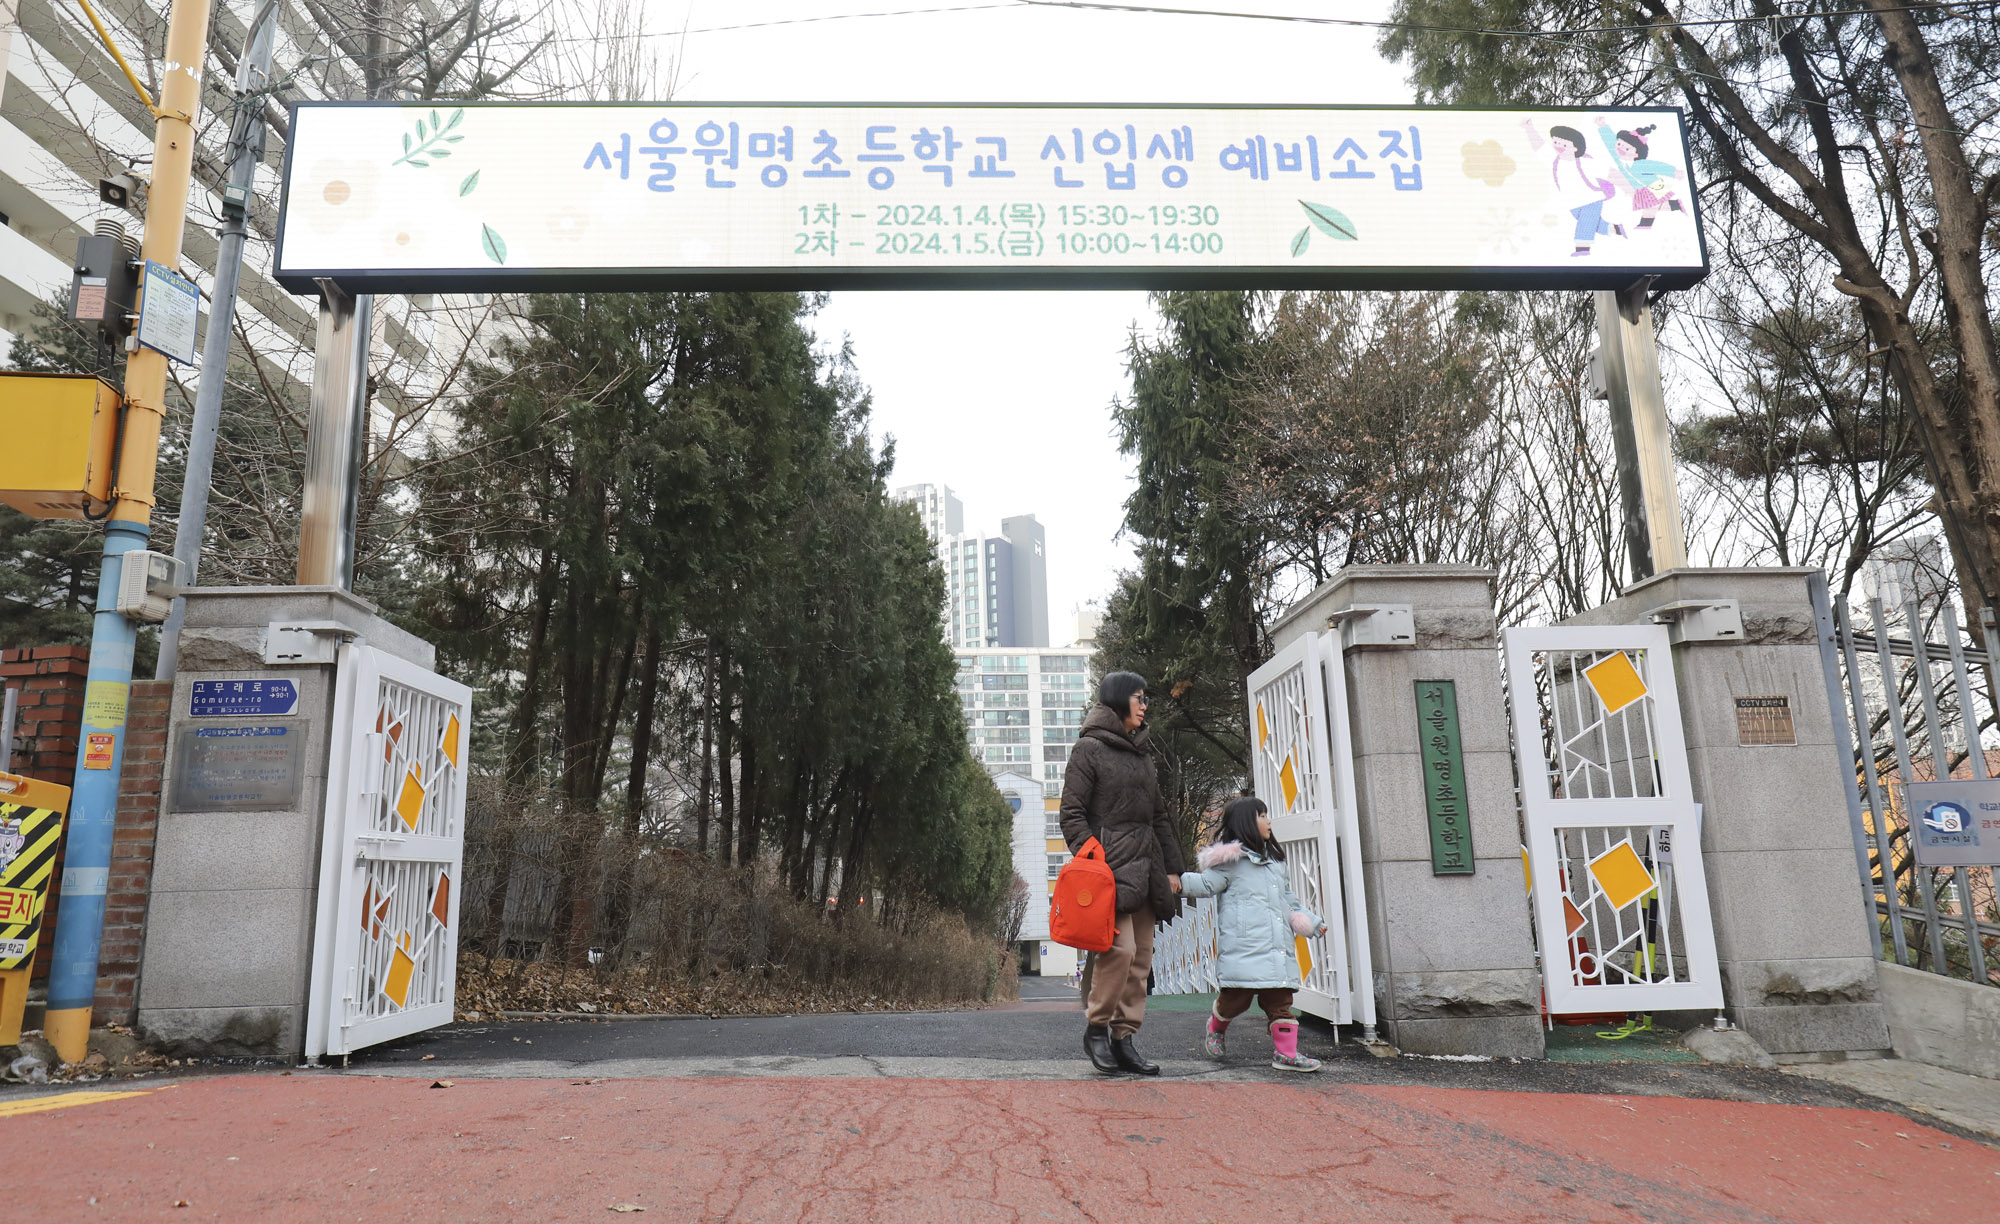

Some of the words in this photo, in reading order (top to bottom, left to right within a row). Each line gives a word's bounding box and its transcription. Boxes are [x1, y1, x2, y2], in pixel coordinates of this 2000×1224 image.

[584, 118, 1015, 193] 서울원명초등학교
[1041, 125, 1194, 190] 신입생
[1220, 126, 1423, 191] 예비소집
[798, 203, 840, 227] 1차
[876, 203, 1046, 229] 2024.1.4.(목)
[1057, 204, 1220, 227] 15:30~19:30
[795, 231, 839, 256] 2차
[875, 231, 1045, 257] 2024.1.5.(금)
[1056, 232, 1224, 255] 10:00~14:00
[194, 682, 262, 693] 고무래로
[1740, 699, 1760, 707] CCTV
[1424, 687, 1465, 869] 서울원명초등학교
